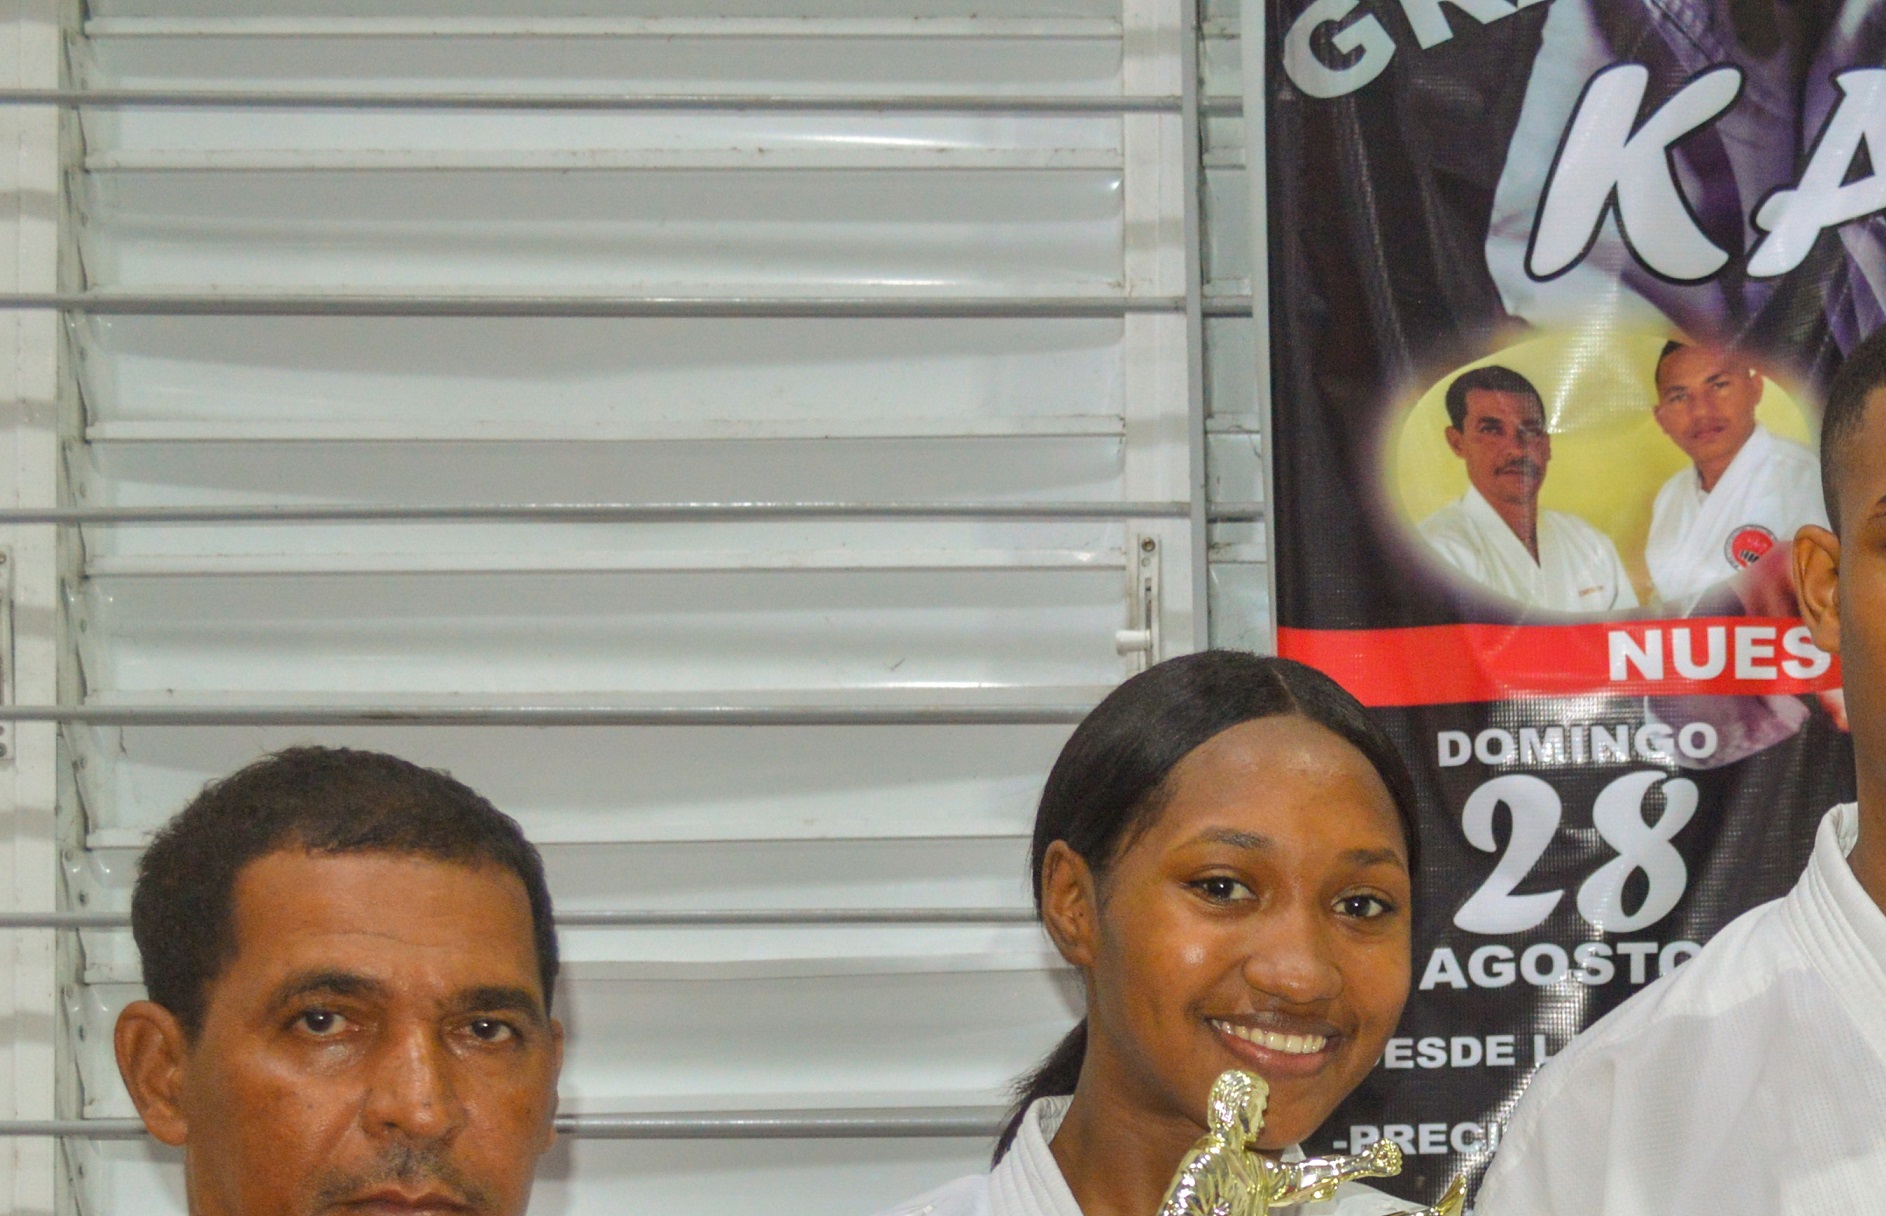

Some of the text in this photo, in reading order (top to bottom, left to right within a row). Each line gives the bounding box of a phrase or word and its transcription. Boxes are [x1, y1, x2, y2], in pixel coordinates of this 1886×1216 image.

[1607, 625, 1831, 682] NUES
[1437, 721, 1718, 768] DOMINGO
[1452, 770, 1699, 935] 28
[1373, 1035, 1516, 1069] ESDE
